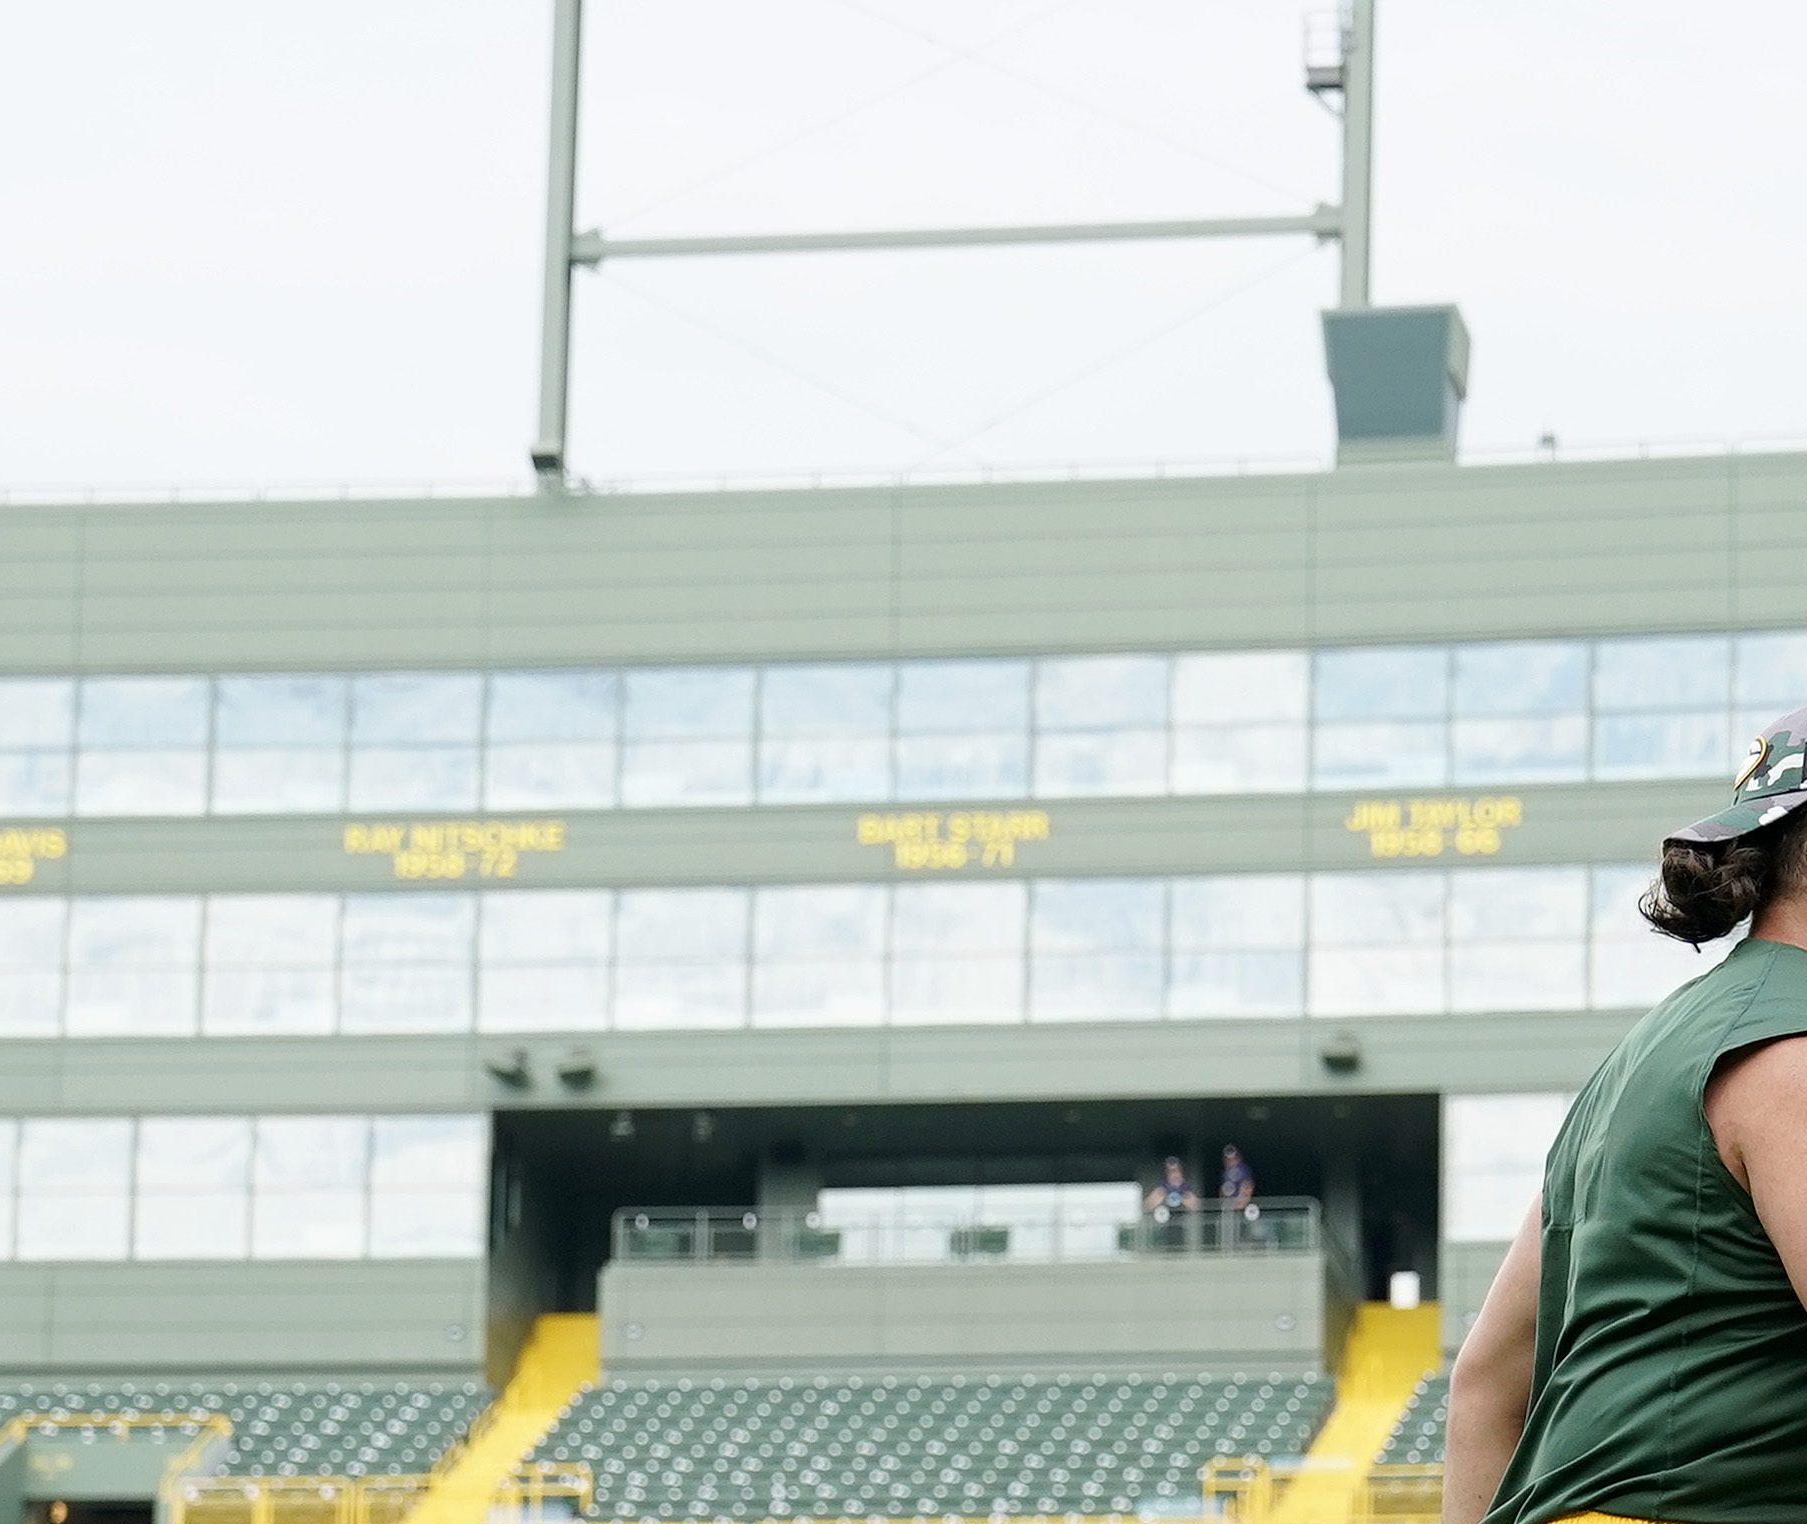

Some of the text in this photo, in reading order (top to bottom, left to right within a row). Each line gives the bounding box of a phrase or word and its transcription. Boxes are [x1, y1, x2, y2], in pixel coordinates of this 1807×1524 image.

[857, 814, 940, 845] BART
[1346, 801, 1401, 832] JIM
[344, 823, 404, 854] RAY
